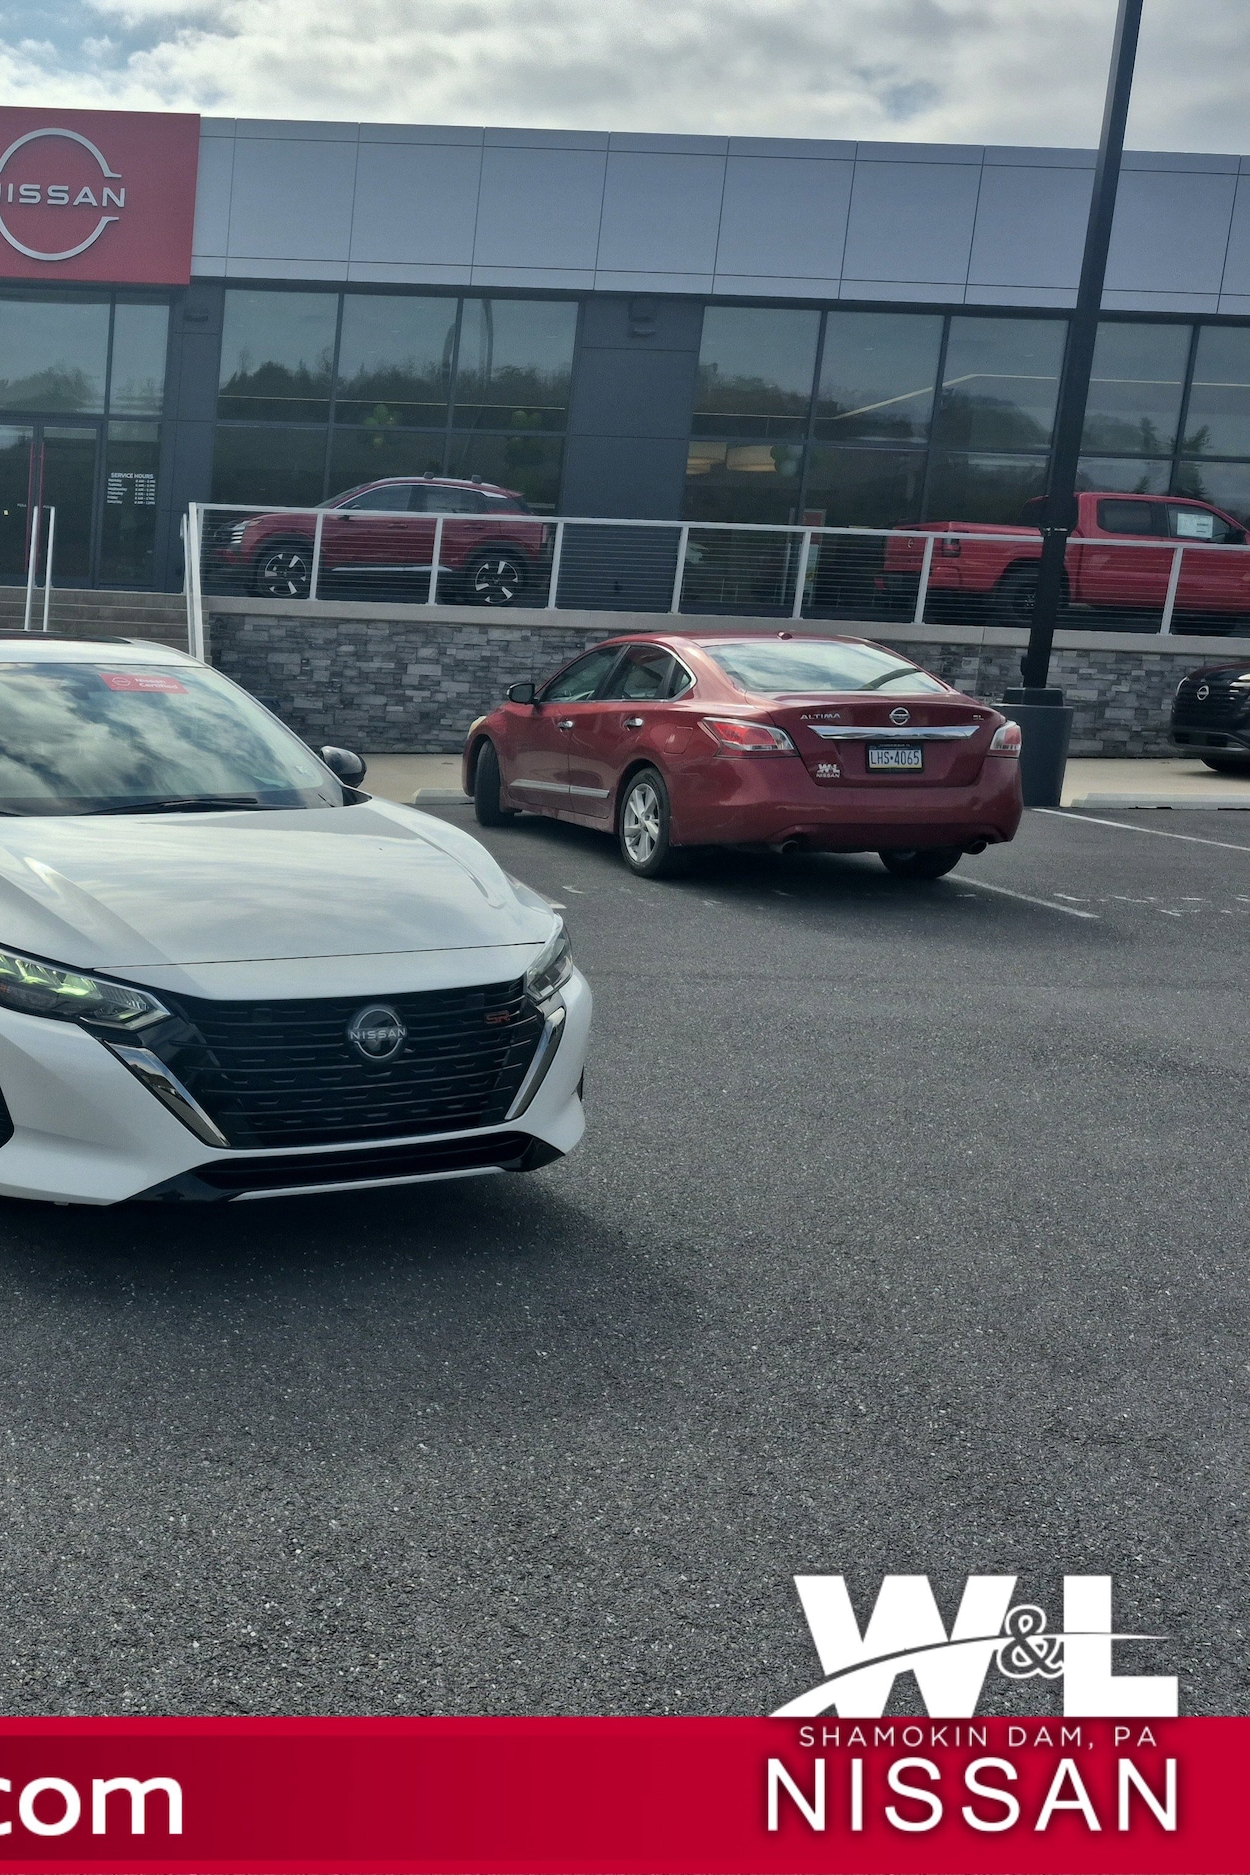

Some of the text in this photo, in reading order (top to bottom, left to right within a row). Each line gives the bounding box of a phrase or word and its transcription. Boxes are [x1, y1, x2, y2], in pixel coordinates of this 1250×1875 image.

[800, 712, 841, 720] ALTIMA
[484, 1010, 511, 1024] SR
[350, 1027, 406, 1040] NISSAN
